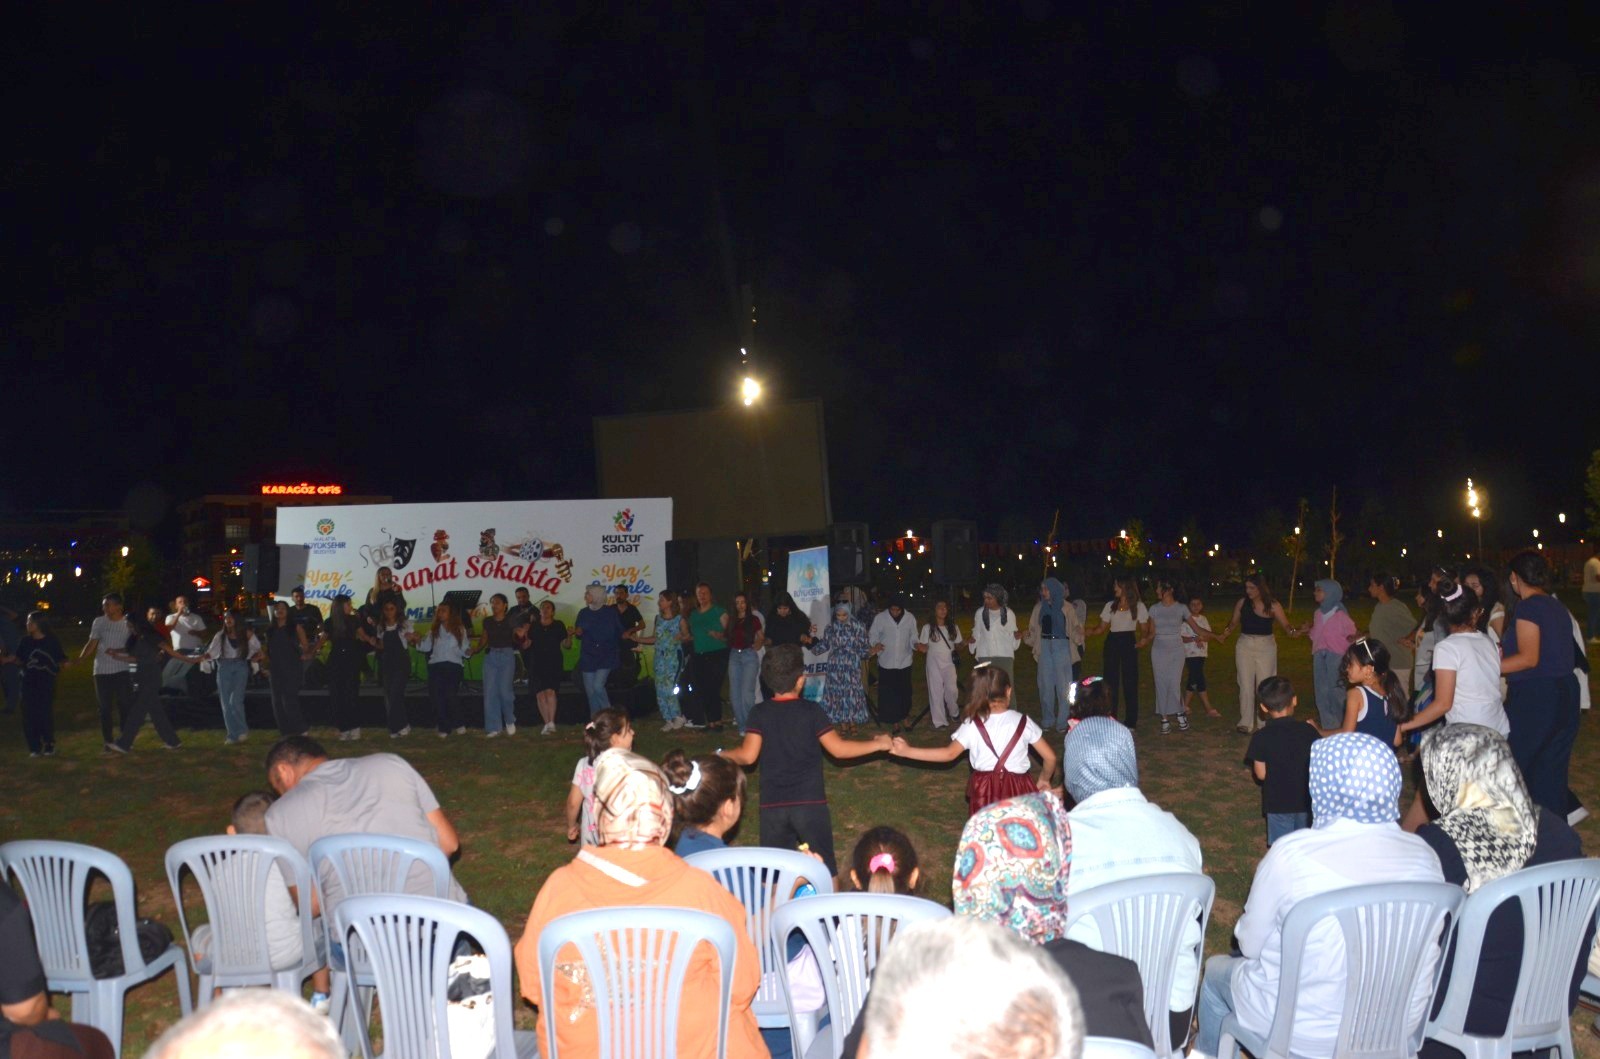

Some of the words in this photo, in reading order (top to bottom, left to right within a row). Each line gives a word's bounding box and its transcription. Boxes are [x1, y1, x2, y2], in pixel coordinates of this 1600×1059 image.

[262, 483, 316, 495] KARAGÖZ
[306, 569, 343, 588] Yaz
[464, 555, 562, 595] Sokakta
[601, 564, 641, 584] Yaz
[302, 584, 356, 599] eninle
